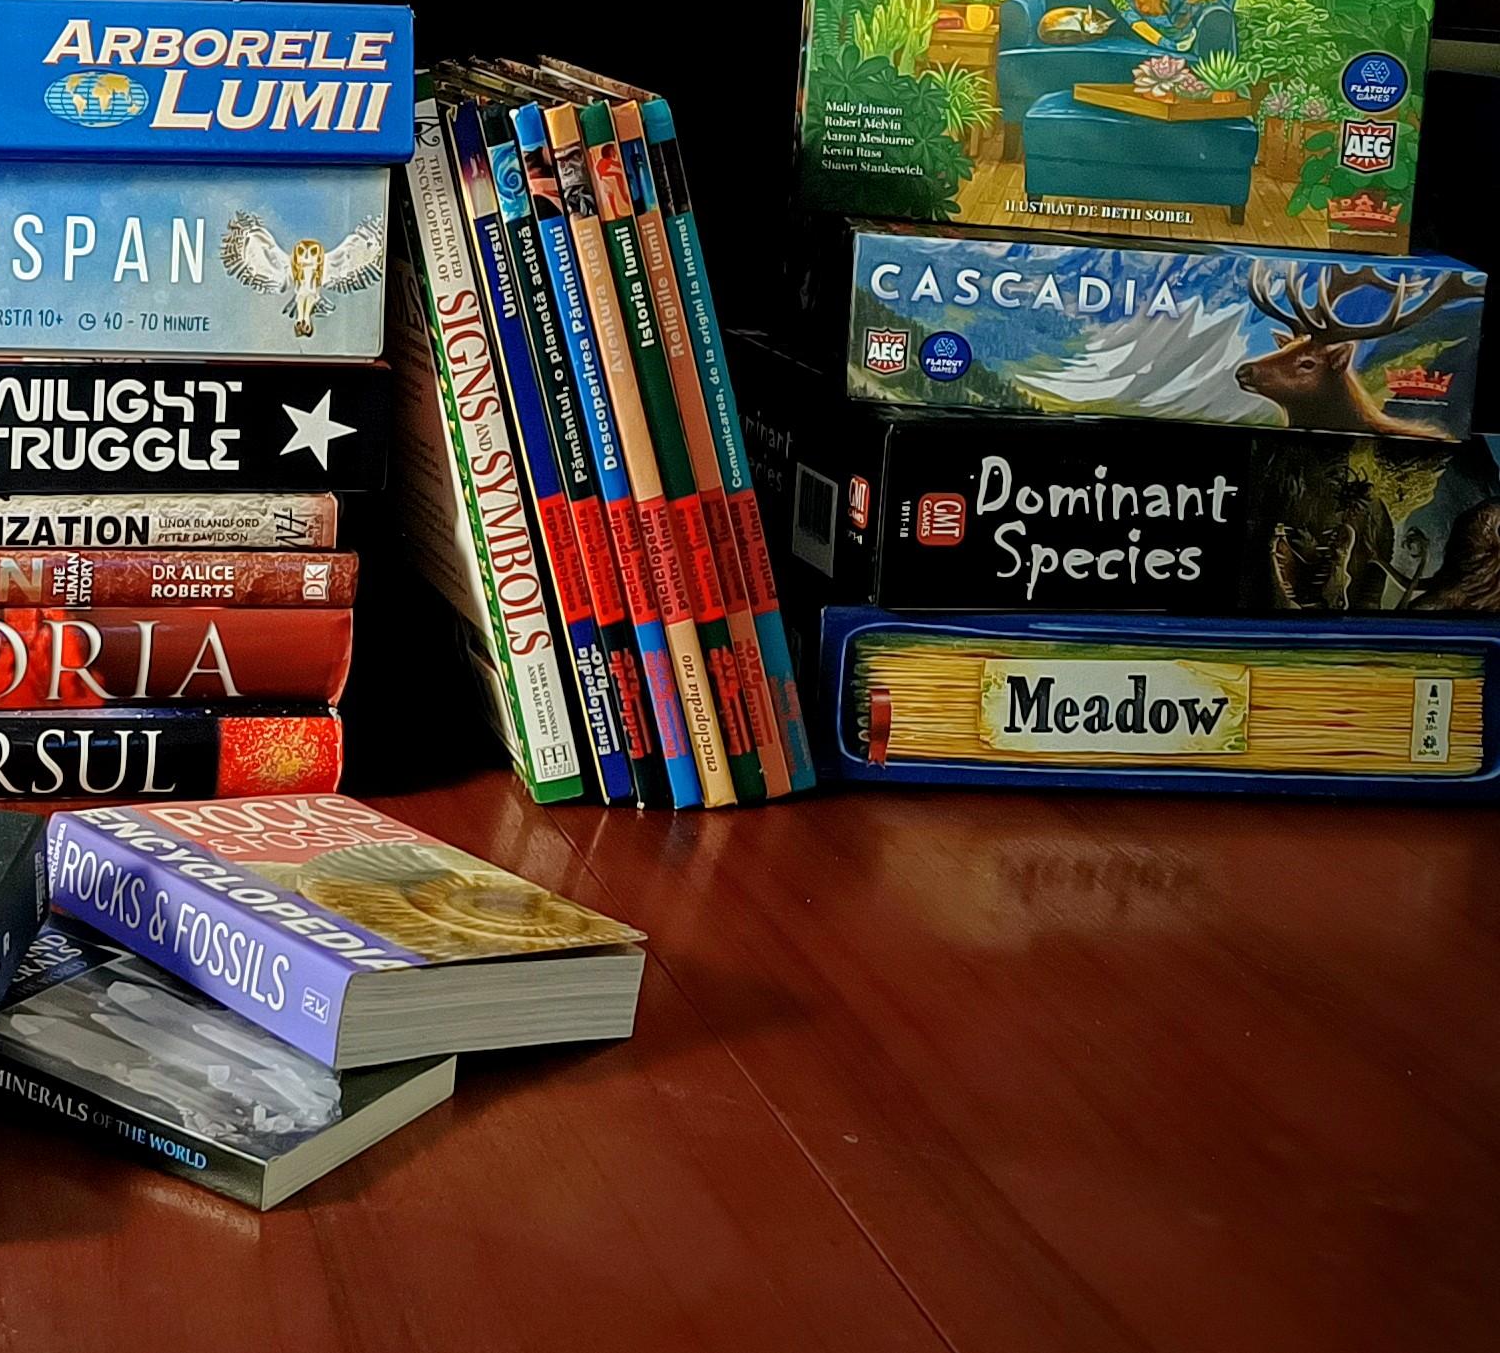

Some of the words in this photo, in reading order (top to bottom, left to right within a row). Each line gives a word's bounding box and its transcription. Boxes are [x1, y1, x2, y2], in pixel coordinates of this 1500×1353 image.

[42, 19, 393, 70] ARBORELE
[150, 69, 392, 132] LUMII
[1350, 84, 1397, 94] FLATOUT
[1356, 93, 1390, 103] GAMES
[824, 116, 860, 128] Robert
[864, 118, 901, 130] Melvin
[825, 101, 856, 116] Molly
[858, 103, 903, 116] Johnson
[822, 160, 858, 171] Shawn
[1345, 135, 1391, 158] AEG
[485, 222, 517, 318] Universul
[614, 226, 639, 277] lumii
[870, 263, 1181, 318] CASCADIA
[38, 309, 64, 328] 10+
[103, 312, 124, 331] 40
[140, 313, 159, 331] 70
[163, 315, 210, 332] MINUTE
[630, 281, 656, 348] Istoria
[436, 289, 501, 423] SIGNS
[868, 341, 905, 361] AEG
[925, 357, 964, 368] FLATOUT
[474, 422, 493, 452] AND
[976, 455, 1238, 523] Dominant
[158, 518, 192, 528] LINDA
[158, 532, 190, 542] PETER
[192, 532, 249, 542] DAVIDSON
[921, 499, 933, 537] GAMES
[933, 500, 962, 538] GMT
[152, 565, 178, 580] DR
[180, 565, 234, 580] ALICE
[470, 450, 552, 657] SYMBOLS
[994, 520, 1202, 600] Species
[53, 565, 65, 596] THE
[66, 552, 80, 606] HUMAN
[80, 558, 93, 603] STORY
[151, 583, 234, 598] ROBERTS
[305, 565, 326, 598] DK
[681, 654, 698, 680] rao
[577, 647, 611, 756] Enciclopedia
[1004, 674, 1229, 735] Meadow
[686, 681, 718, 772] enciclopedia
[150, 798, 384, 836] ROCKS
[59, 840, 146, 929] ROCKS
[149, 890, 169, 945] &
[174, 902, 291, 1012] FOSSILS
[92, 1110, 114, 1129] OF
[116, 1119, 146, 1145] THE
[149, 1132, 208, 1170] WORLD
